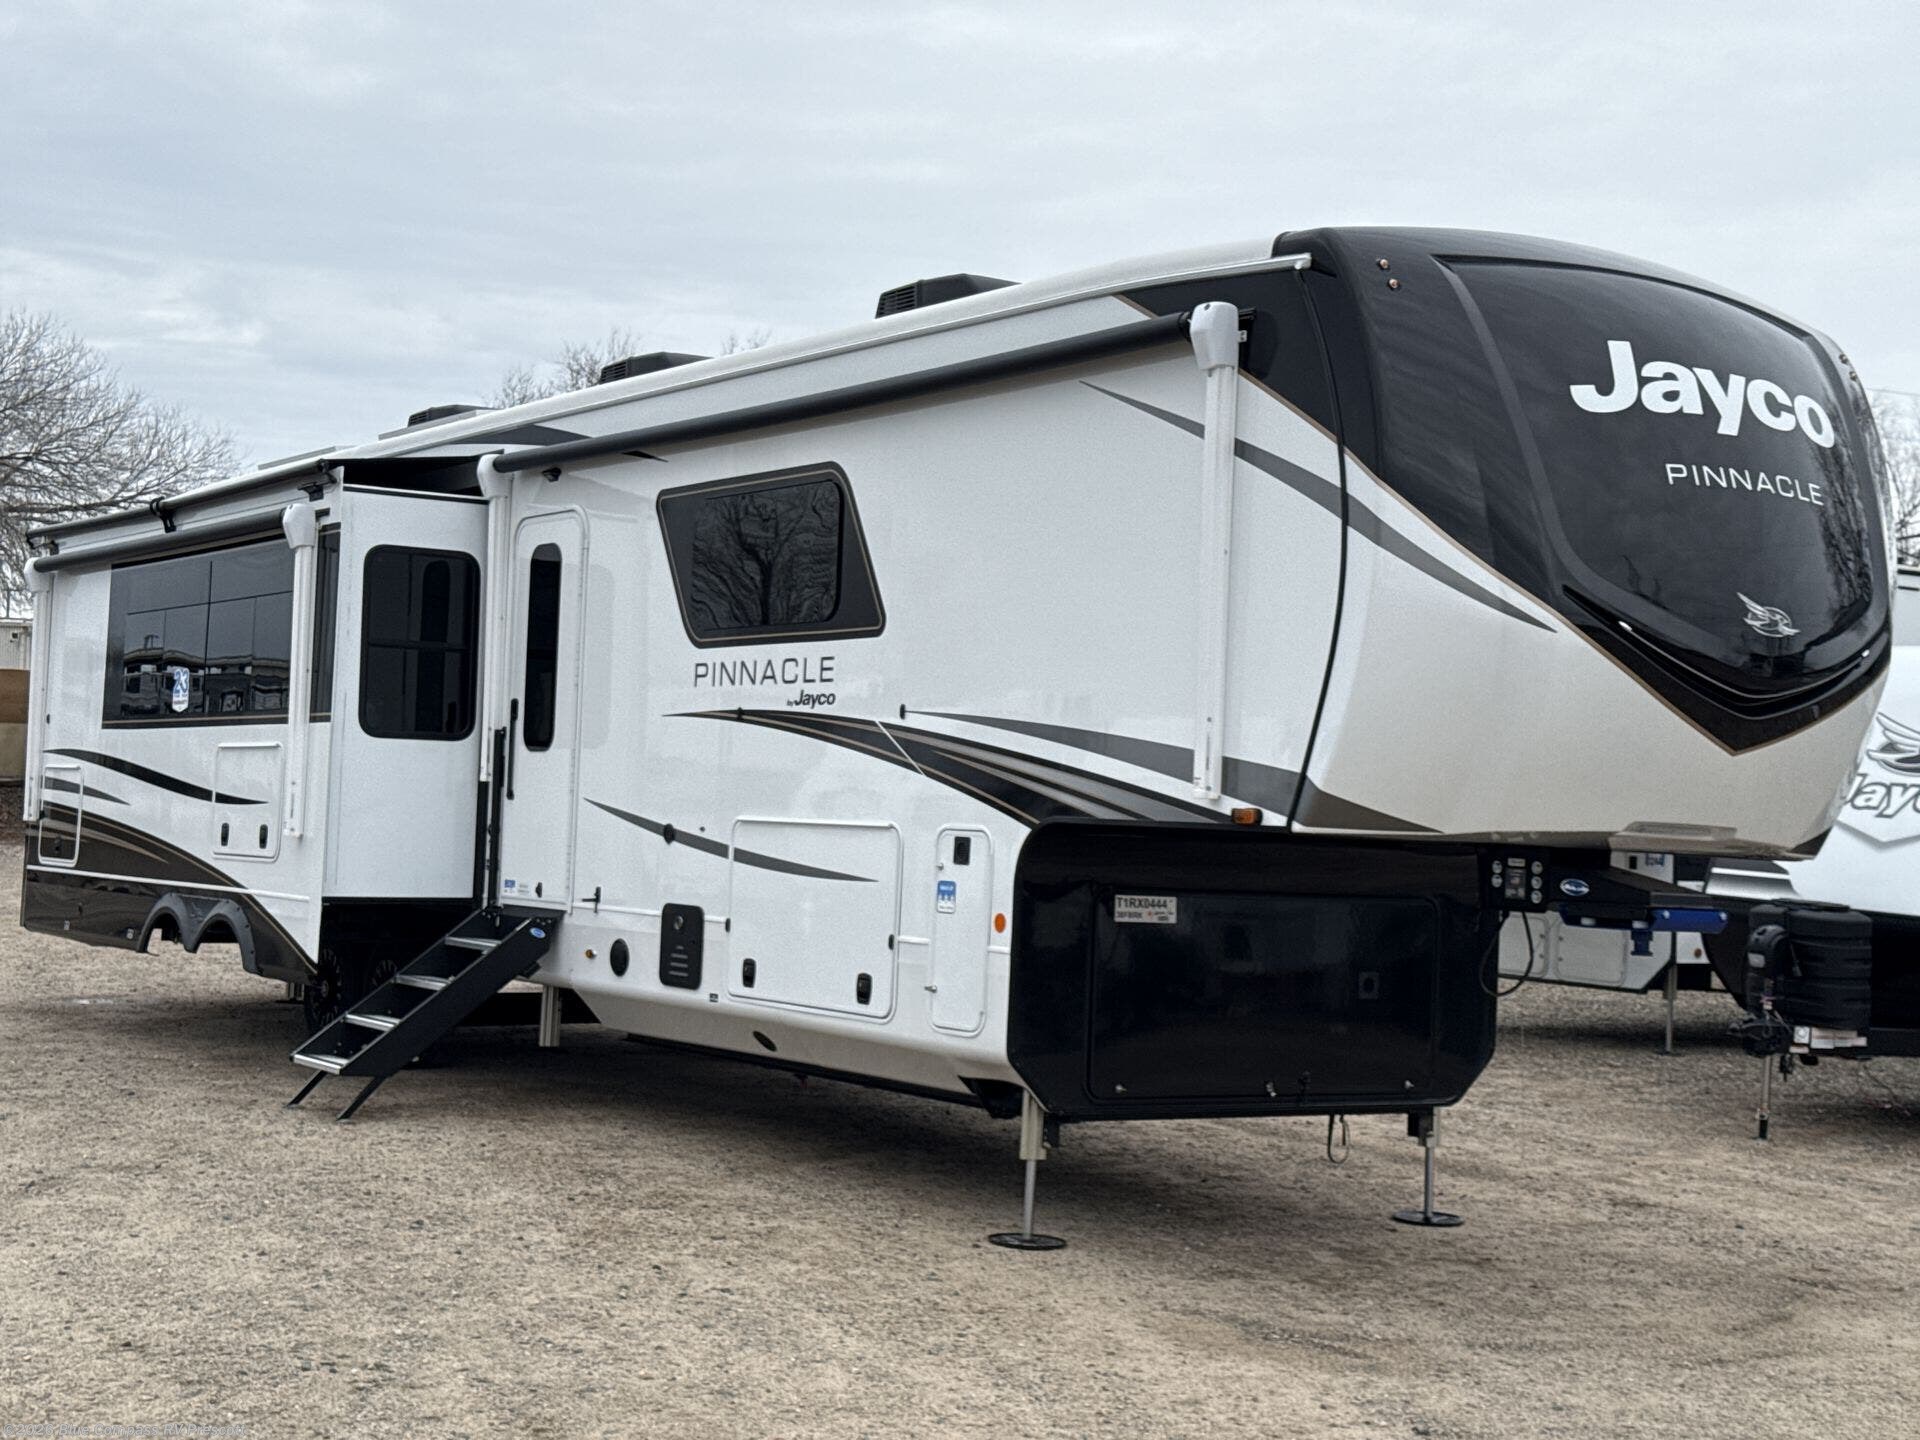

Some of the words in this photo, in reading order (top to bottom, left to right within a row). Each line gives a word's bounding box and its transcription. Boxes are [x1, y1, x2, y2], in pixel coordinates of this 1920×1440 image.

[1569, 340, 1835, 448] Jayco
[1665, 463, 1824, 505] PINNACLE
[694, 656, 835, 688] PINNACLE
[794, 689, 836, 710] Jayco
[1840, 773, 1920, 819] Jay
